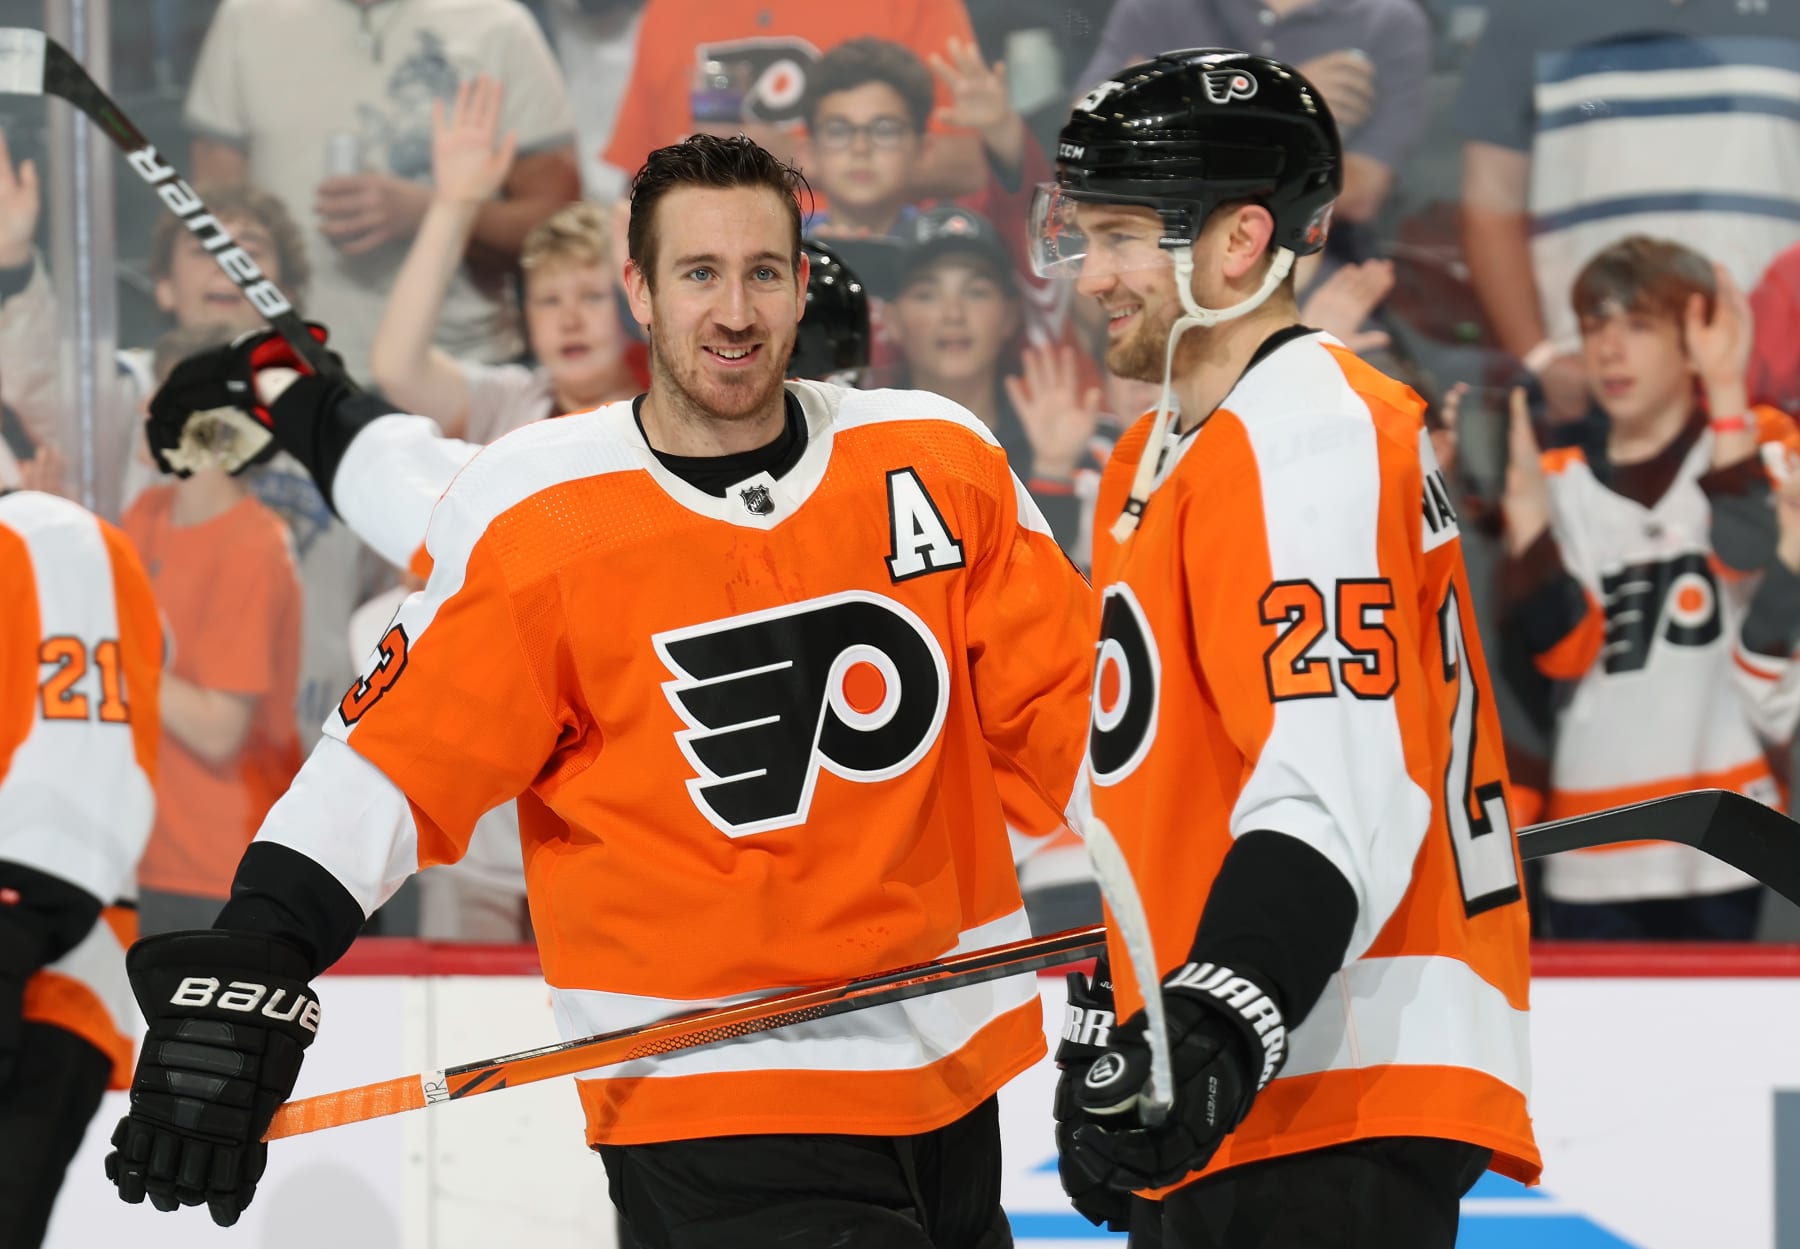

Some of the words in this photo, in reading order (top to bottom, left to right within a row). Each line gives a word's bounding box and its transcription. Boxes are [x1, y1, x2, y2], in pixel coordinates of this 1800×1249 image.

[1059, 143, 1085, 160] CCM
[127, 144, 292, 318] BAUER
[883, 466, 967, 585] A
[38, 635, 131, 723] 21
[1257, 577, 1400, 704] 25
[1163, 961, 1285, 1092] WARRIO
